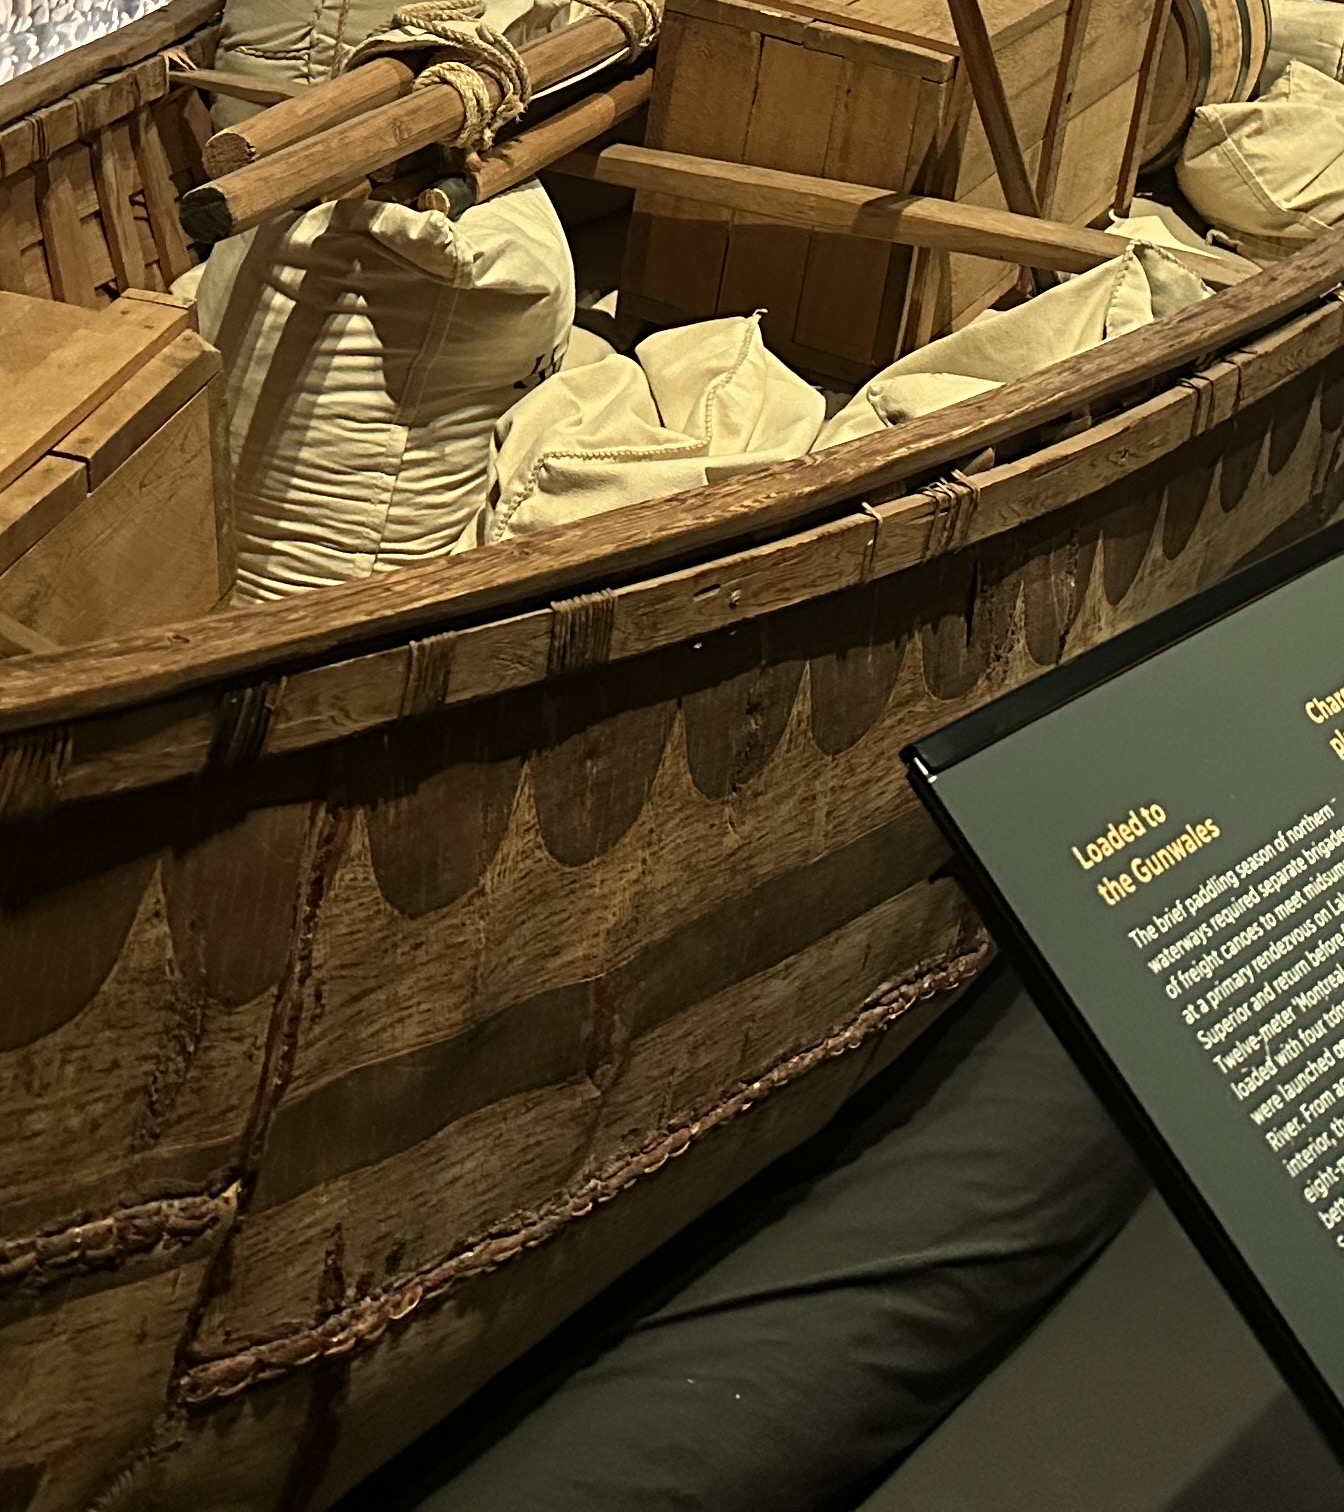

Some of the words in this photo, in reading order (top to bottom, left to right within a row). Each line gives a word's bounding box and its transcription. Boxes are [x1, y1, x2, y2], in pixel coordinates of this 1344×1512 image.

[1071, 810, 1147, 870] Loaded
[1140, 803, 1167, 827] to
[1097, 876, 1136, 906] the
[1130, 818, 1221, 883] Gunwales
[1127, 923, 1159, 949] The
[1152, 901, 1188, 933] brief
[1183, 869, 1240, 916] paddling
[1234, 844, 1278, 879] season
[1272, 833, 1290, 853] of
[1284, 803, 1335, 844] northern
[1146, 921, 1214, 975] waterways
[1208, 886, 1262, 932] required
[1256, 856, 1308, 899] separate
[1164, 975, 1182, 999] of
[1176, 949, 1225, 990] freight
[1219, 921, 1265, 960] canoes
[1257, 911, 1277, 930] to
[1272, 889, 1308, 921] meet
[1180, 1003, 1201, 1025] at
[1195, 997, 1210, 1014] a
[1205, 963, 1255, 1010] primary
[1250, 918, 1318, 974] rendezvous
[1312, 907, 1333, 928] on
[1195, 1001, 1253, 1051] Superior
[1248, 981, 1277, 1012] and
[1271, 958, 1312, 994] return
[1211, 1005, 1297, 1074] Twelve-meter
[1229, 1054, 1279, 1101] loaded
[1273, 1037, 1305, 1067] with
[1297, 1018, 1328, 1048] four
[1249, 1093, 1284, 1126] were
[1276, 1046, 1336, 1102] launched
[1264, 1116, 1307, 1152] River.
[1298, 1089, 1337, 1124] From
[1281, 1130, 1338, 1178] interior,
